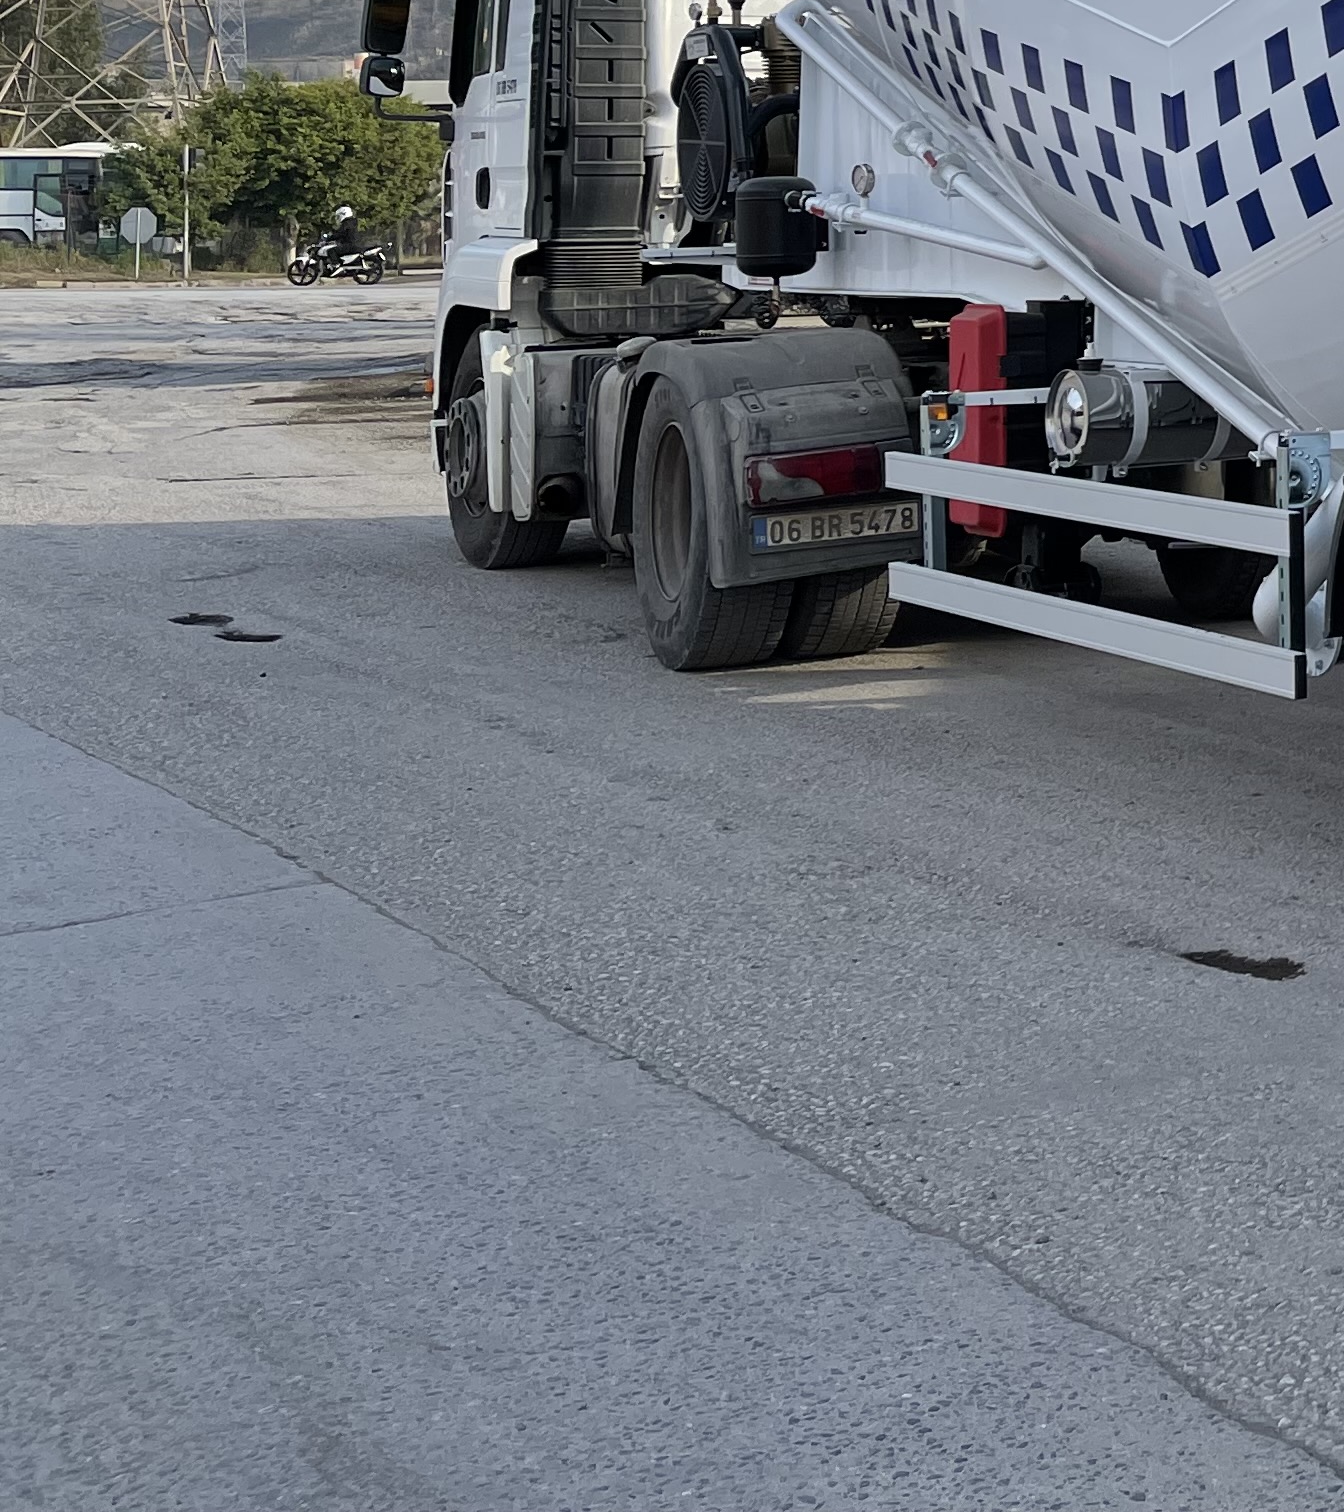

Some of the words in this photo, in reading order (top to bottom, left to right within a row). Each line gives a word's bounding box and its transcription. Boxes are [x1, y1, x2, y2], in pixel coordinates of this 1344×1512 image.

[770, 519, 801, 544] 06
[811, 514, 842, 540] BR
[850, 507, 913, 536] 5478
